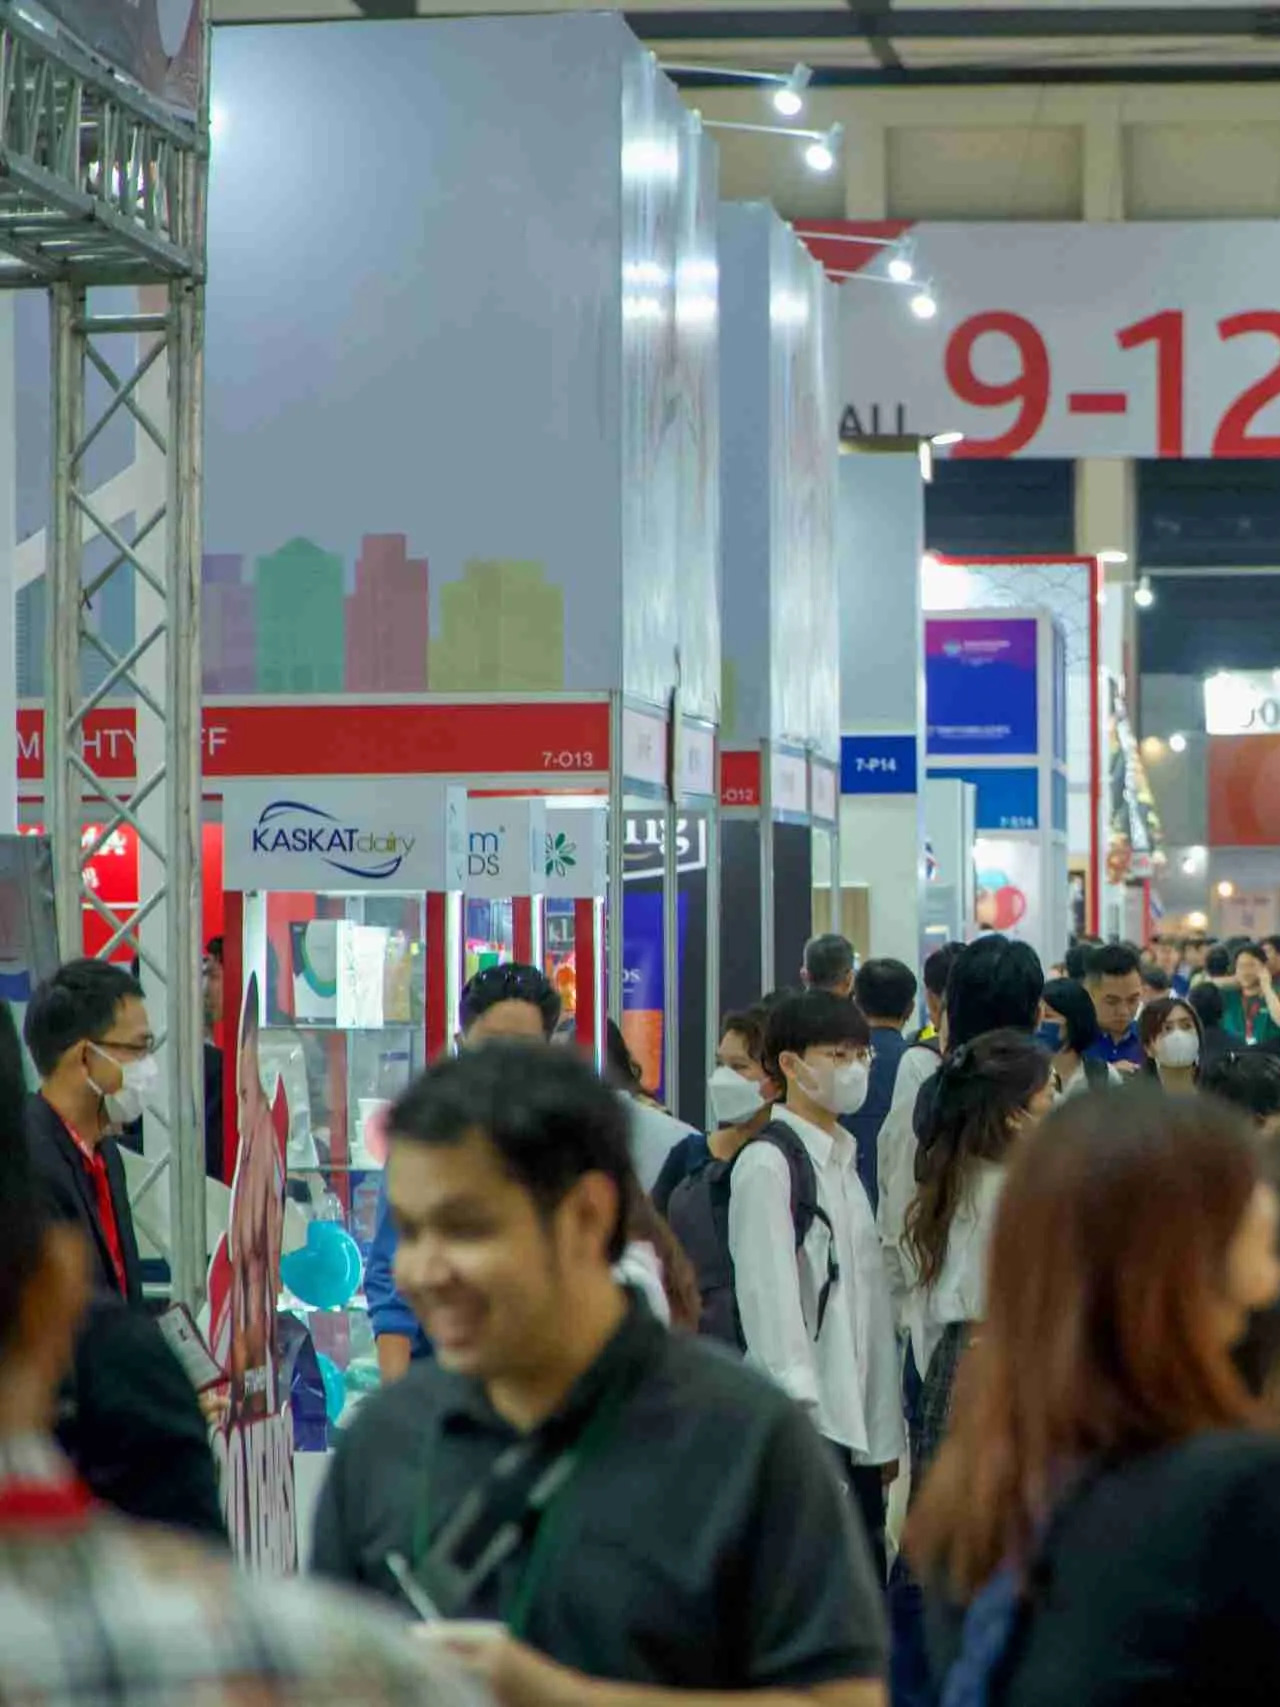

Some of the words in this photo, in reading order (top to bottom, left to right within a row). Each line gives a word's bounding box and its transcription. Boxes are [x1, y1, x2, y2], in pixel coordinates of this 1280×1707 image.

[838, 403, 904, 436] ALL
[16, 728, 137, 759] MHTY
[722, 788, 754, 802] -O12
[468, 855, 500, 876] DS
